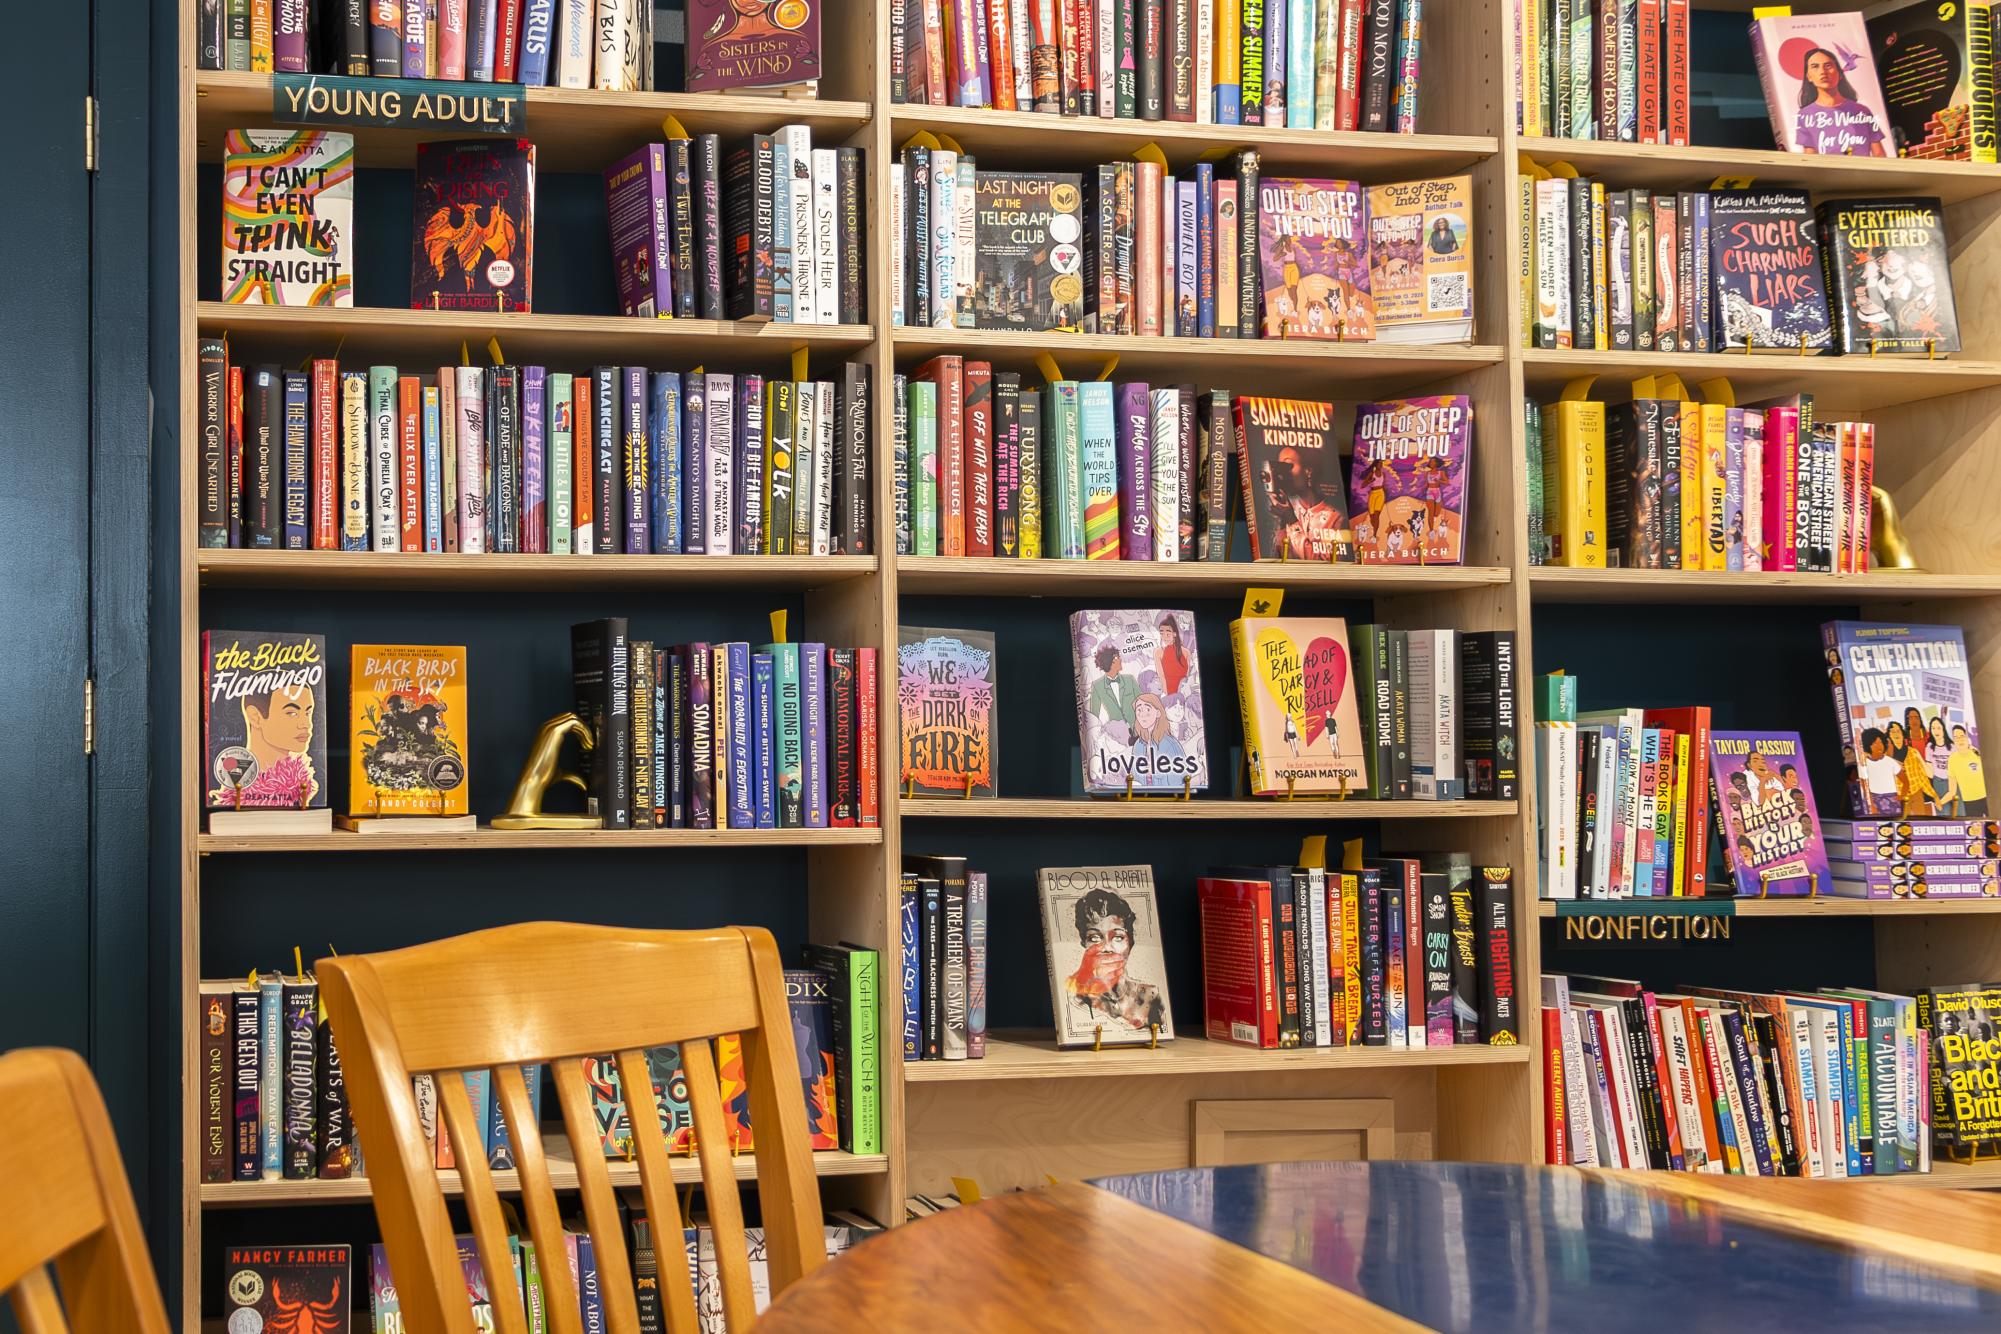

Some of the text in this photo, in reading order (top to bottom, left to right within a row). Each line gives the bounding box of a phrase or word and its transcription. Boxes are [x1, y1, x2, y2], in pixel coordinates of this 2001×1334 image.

[719, 39, 776, 58] SISTERS
[737, 53, 792, 76] WIND
[1604, 13, 1616, 127] CEMETERY BOYS
[1644, 12, 1655, 134] THE HATE U GIVE
[285, 86, 517, 124] YOUNG ADULT
[1819, 112, 1833, 126] Be
[1835, 112, 1880, 132] Waiting
[251, 144, 325, 156] DEAN ATTA
[1818, 129, 1866, 155] for You
[246, 166, 327, 189] I CAN'T
[976, 179, 1055, 195] LAST NIGHT
[1385, 183, 1457, 197] Out of Step,
[257, 193, 314, 215] EVEN
[757, 150, 772, 244] BLOOD DEBTS
[993, 199, 1021, 208] AT THE
[1262, 188, 1358, 217] OUT OF STEP,
[1395, 193, 1448, 208] Into You
[818, 210, 832, 256] STOLEN
[1273, 215, 1353, 239] INTO YOU
[1838, 210, 1935, 229] EVERYTHING
[235, 219, 333, 254] THINK
[1011, 229, 1045, 243] CLUB
[1181, 200, 1194, 290] NOWHERE BOY
[1731, 220, 1798, 249] SUCH
[1849, 229, 1929, 247] GLITTERED
[1522, 227, 1530, 276] CONTIGO
[1724, 247, 1813, 272] CHARMING
[228, 259, 341, 284] STRAIGHT
[1750, 274, 1816, 306] LIARS
[600, 372, 611, 474] BALANCING ACT
[974, 411, 984, 434] OFF
[1252, 400, 1329, 430] SOMETHING
[1361, 407, 1460, 439] OUT OF STEP,
[206, 372, 220, 512] WARRIOR GIRL UNEARTHED
[1084, 439, 1111, 448] WHEN
[1264, 429, 1323, 448] KINDRED
[1368, 435, 1451, 461] INTO YOU
[288, 402, 306, 526] THE HAWTHORNE LEGACY
[974, 440, 986, 466] WITH
[1084, 462, 1114, 470] WORLD
[406, 418, 416, 525] FELIX EVER AFTER
[1022, 427, 1035, 525] FURYSONG
[1089, 473, 1109, 483] TIPS
[1089, 488, 1112, 496] OVER
[1796, 443, 1811, 548] ONE BOYS
[974, 509, 987, 545] HEADS
[1710, 487, 1725, 553] LIBERTAD
[1123, 641, 1154, 654] oseman
[1126, 634, 1145, 644] alice
[1262, 640, 1287, 656] THE
[215, 639, 320, 671] the Black
[365, 658, 457, 676] BLACK BIRDS
[1271, 647, 1336, 681] BALLAD OF
[1498, 642, 1510, 672] INTO
[1850, 641, 1960, 674] GENERATION
[212, 665, 322, 703] Flamingo
[375, 678, 447, 695] IN THE SKY
[1280, 673, 1319, 696] DARCY
[1855, 673, 1917, 704] QUEER
[922, 700, 967, 730] DARK
[1287, 689, 1336, 713] RUSSELL
[1377, 680, 1391, 747] ROAD HOME
[1500, 689, 1513, 728] LIGHT
[694, 704, 710, 772] SOMADINA
[783, 683, 798, 769] NO GOING BACK
[909, 731, 981, 774] FIRE
[1100, 748, 1199, 775] loveless
[1714, 740, 1796, 755] TAYLOR CASSIDY
[1275, 769, 1358, 778] MORGAN MATSON
[1656, 735, 1670, 838] THIS BOOK GAY
[1741, 788, 1795, 820] BLACK
[1744, 805, 1796, 833] HISTORY
[1750, 822, 1803, 852] YOUR
[1752, 839, 1805, 867] HISTORY
[1048, 872, 1098, 890] BLOOD
[1427, 933, 1449, 949] CARRY
[1566, 915, 1730, 939] NONFICTION
[947, 906, 963, 1030] TREACHERY SWANS
[1429, 952, 1446, 968] ON
[1490, 930, 1513, 997] FIGHTING
[1936, 998, 1969, 1011] David
[238, 997, 257, 1091] IF THIS GETS OUT
[1944, 1033, 2000, 1063] Blac
[210, 1050, 221, 1073] OUR
[1828, 1049, 1841, 1100] STAMPED
[1678, 1068, 1692, 1106] HAPPENS
[1951, 1062, 1997, 1091] and
[1875, 1043, 1897, 1145] ACCOUNTABLE
[233, 1251, 346, 1264] NANCY FARMER
